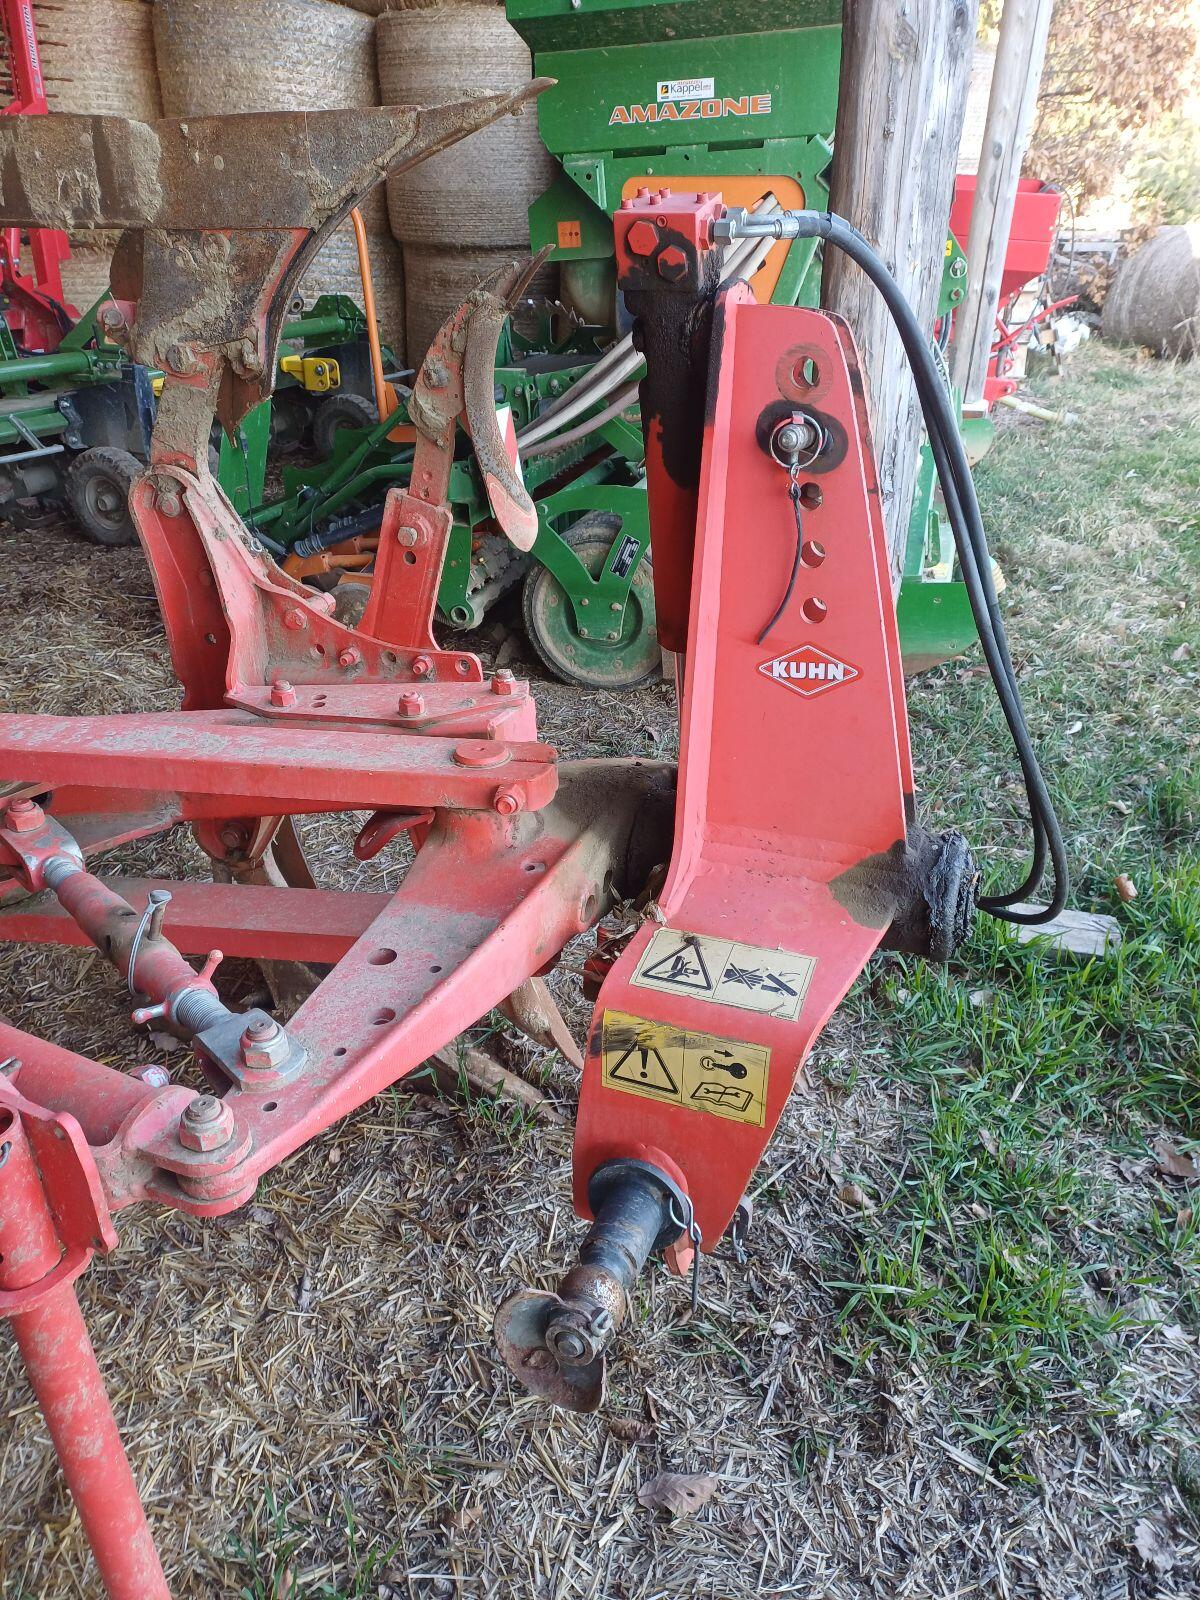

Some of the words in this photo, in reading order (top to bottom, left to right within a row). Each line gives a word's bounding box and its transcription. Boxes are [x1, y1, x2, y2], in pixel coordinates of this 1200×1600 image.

[670, 81, 703, 94] Kappel
[608, 94, 772, 126] AMAZONE
[772, 661, 845, 681] KUHN
